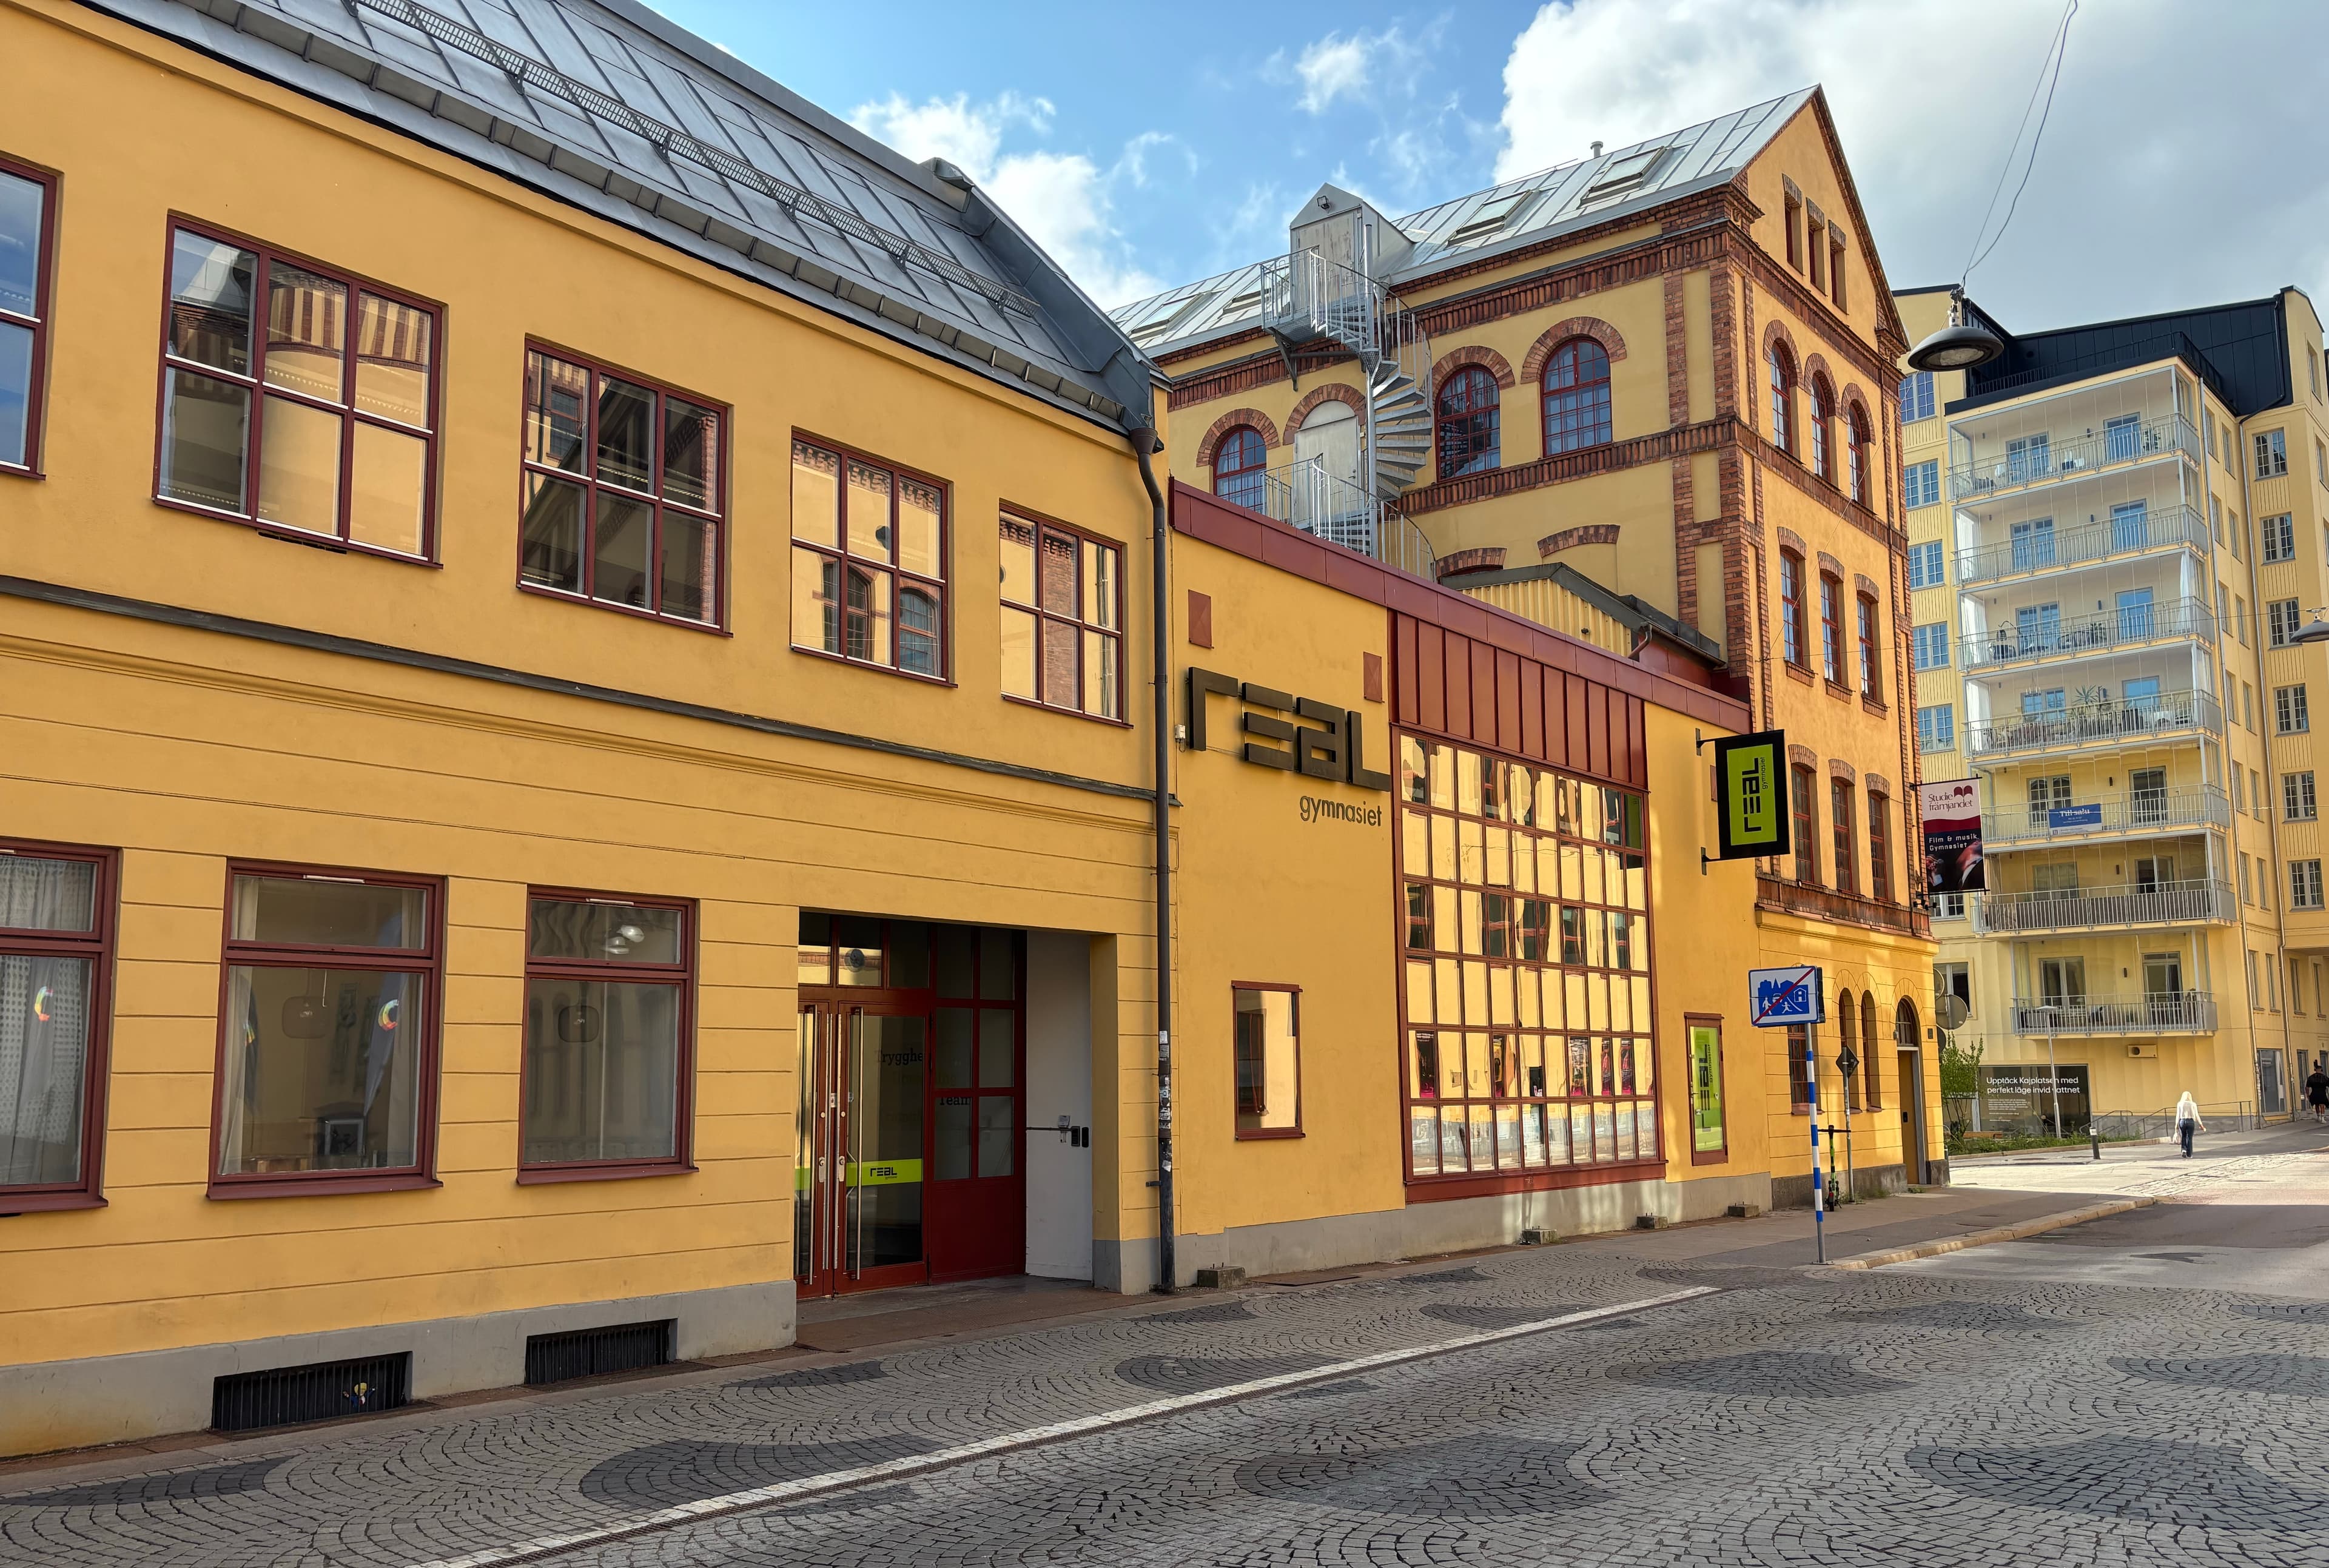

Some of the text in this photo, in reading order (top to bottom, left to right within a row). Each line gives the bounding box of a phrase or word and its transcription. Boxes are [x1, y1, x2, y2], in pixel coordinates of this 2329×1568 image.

[1929, 792, 1953, 802] Studie
[1929, 799, 1973, 812] främjandet
[1300, 795, 1382, 827] gymnasiet
[1929, 843, 1968, 852] Gymnasiet
[2015, 1086, 2032, 1095] läge
